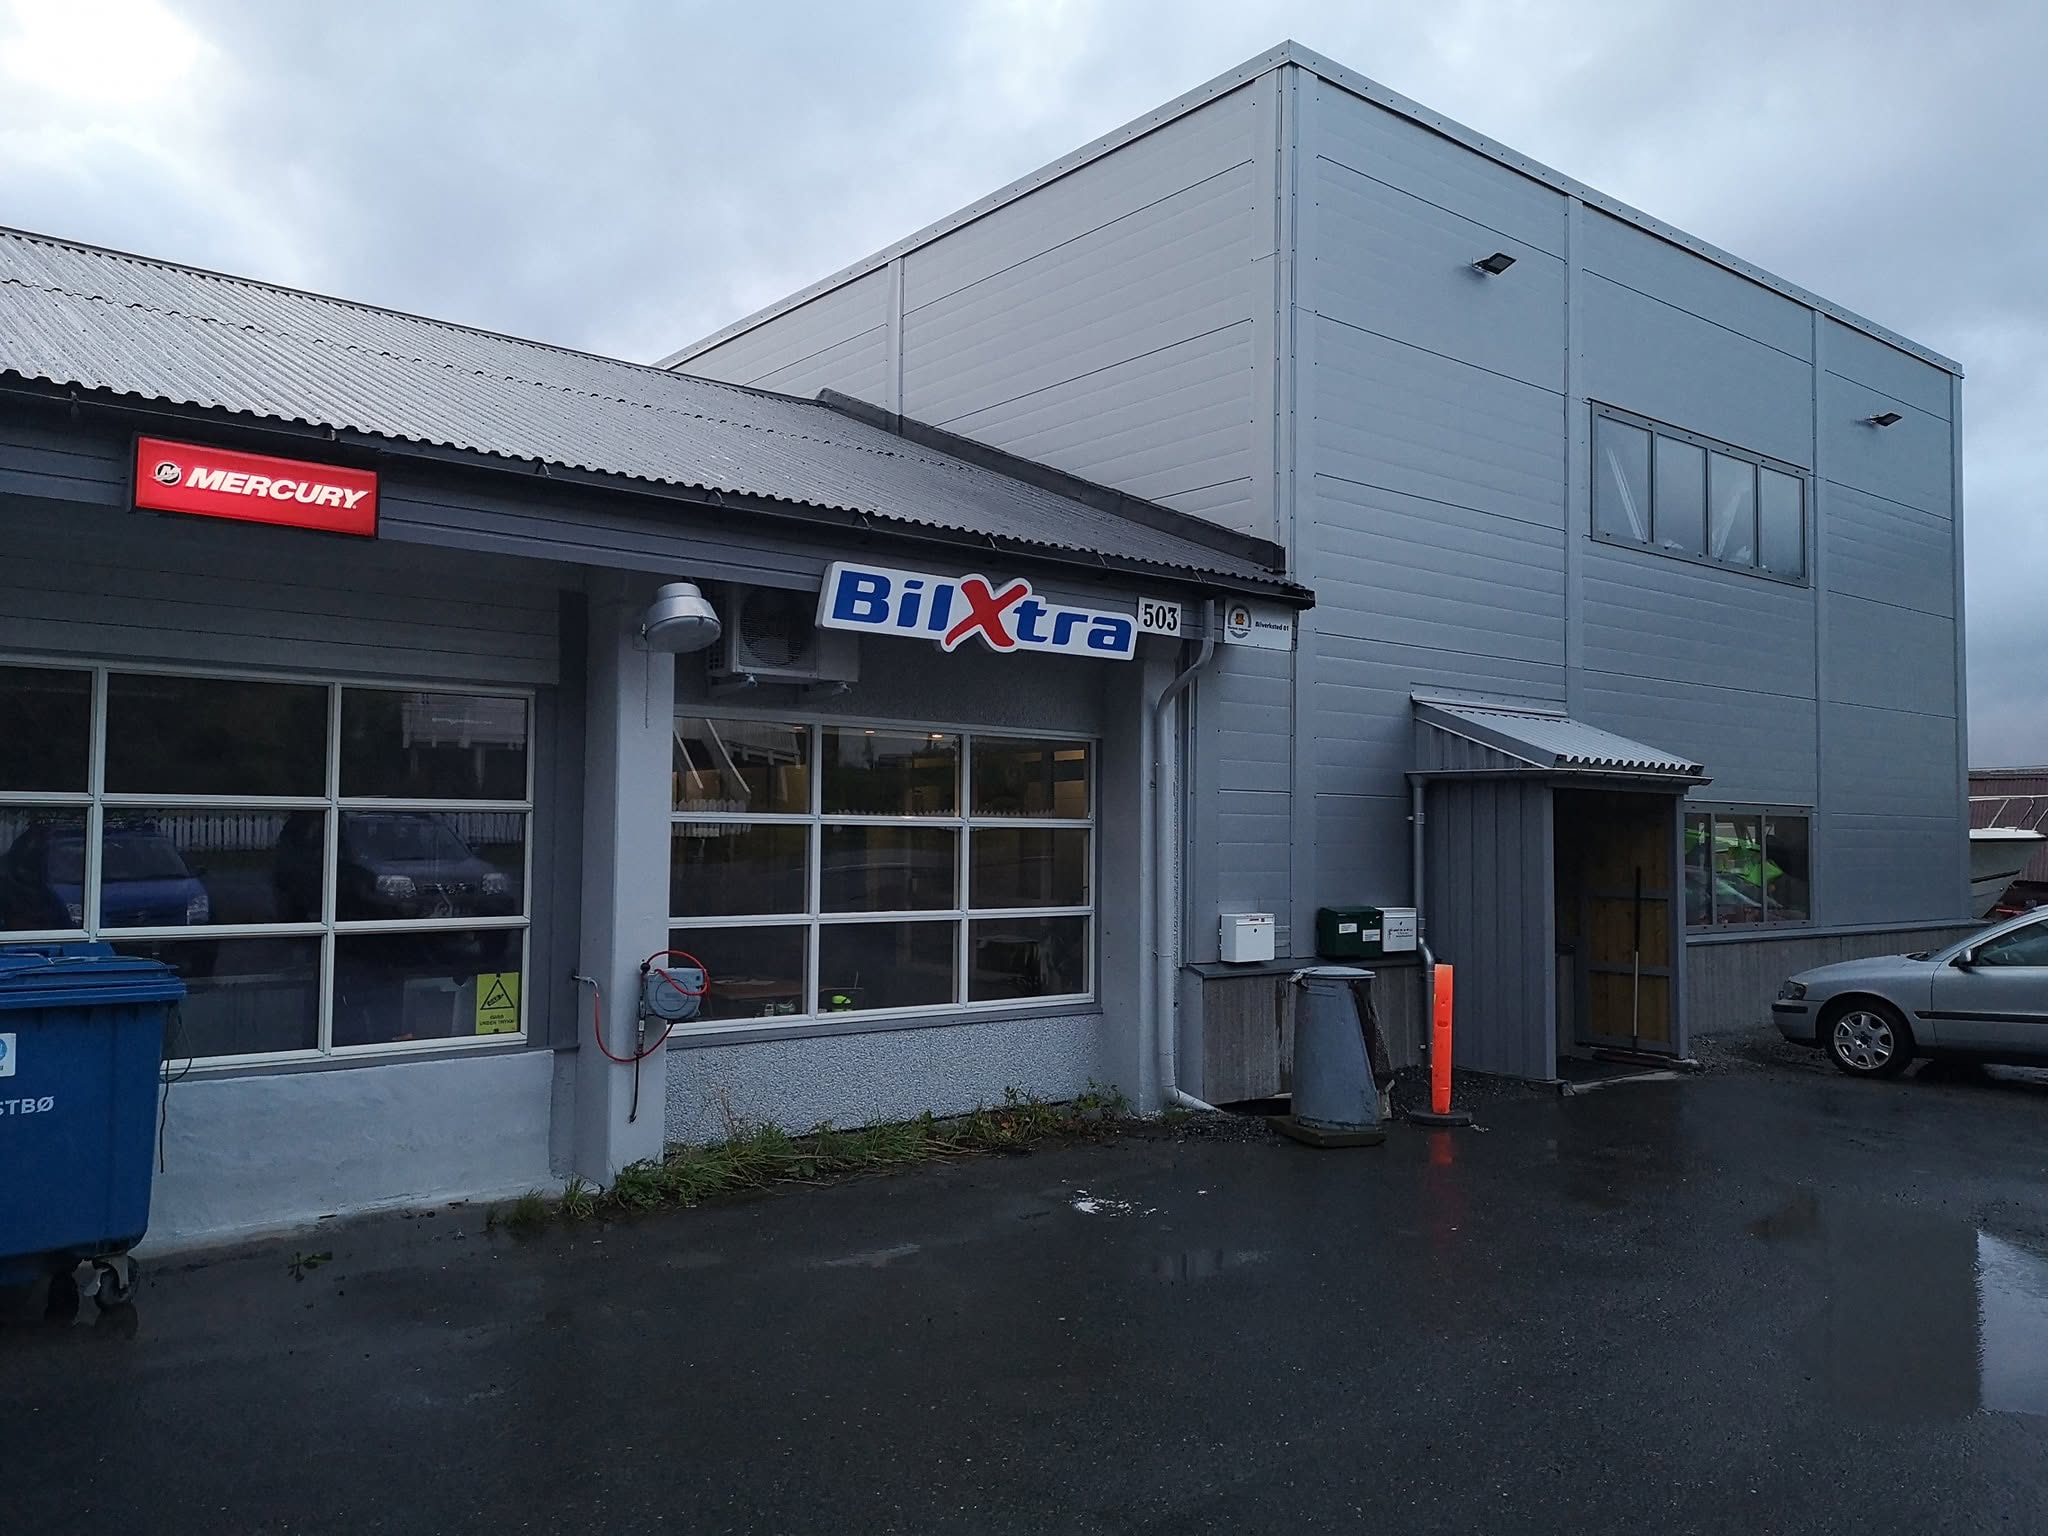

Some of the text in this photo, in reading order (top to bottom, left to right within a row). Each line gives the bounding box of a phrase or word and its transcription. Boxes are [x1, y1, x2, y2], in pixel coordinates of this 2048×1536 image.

[185, 467, 368, 509] MERCURY
[831, 569, 1133, 653] BilXtra
[1142, 603, 1178, 632] 503
